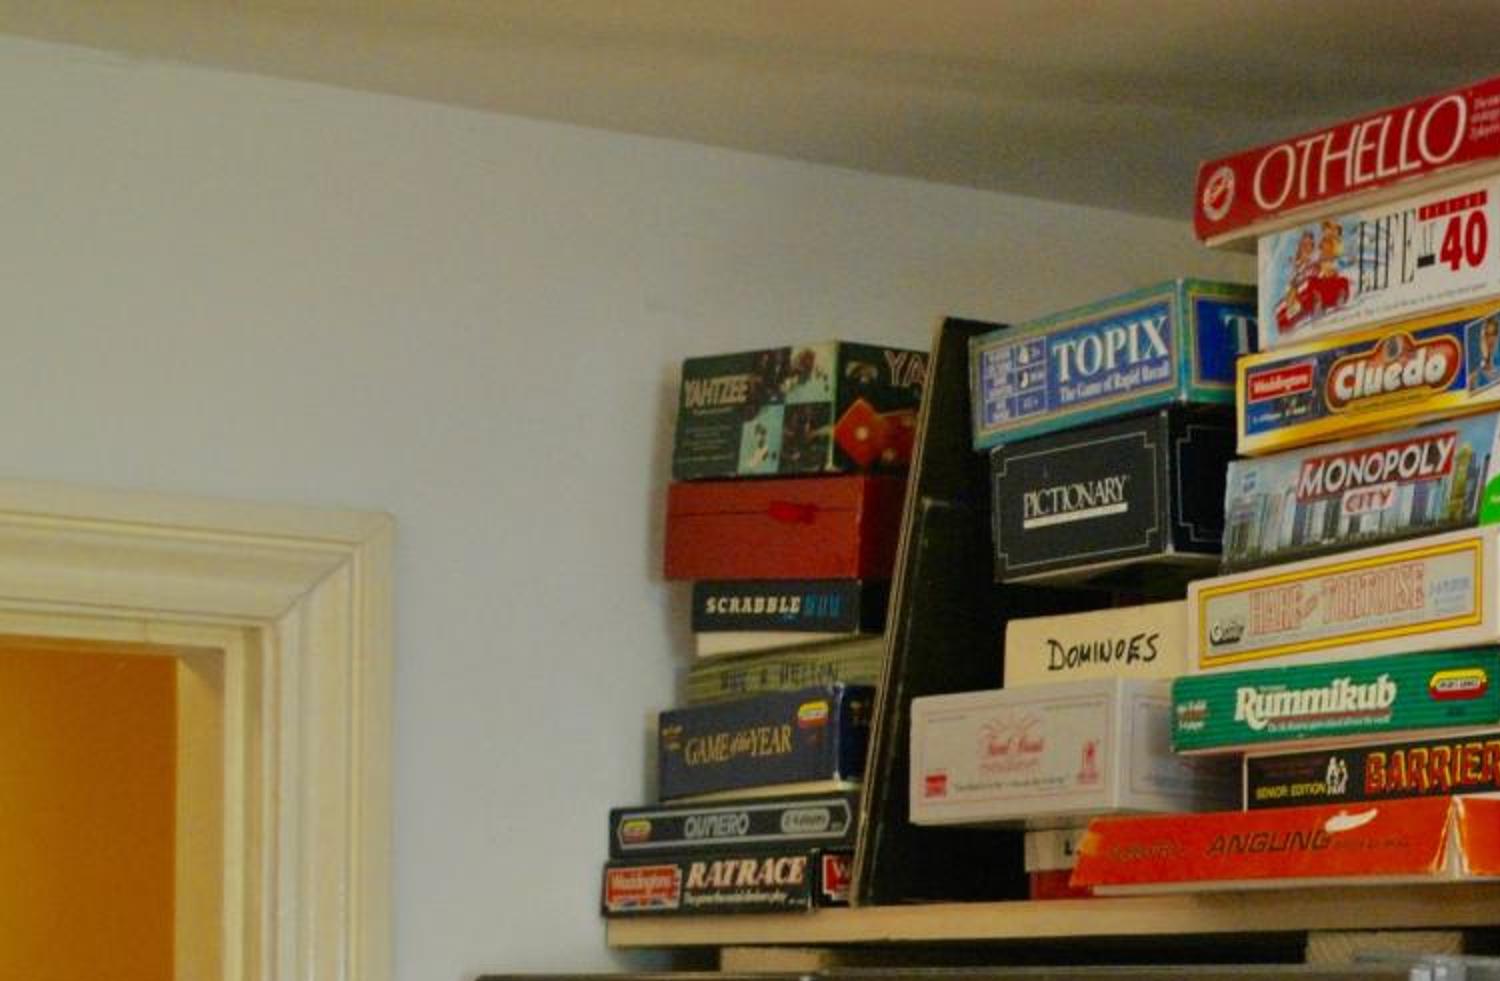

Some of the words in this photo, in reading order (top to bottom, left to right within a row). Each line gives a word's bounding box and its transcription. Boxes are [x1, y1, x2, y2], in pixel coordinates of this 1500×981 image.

[1253, 95, 1467, 209] OTHELLO
[1439, 210, 1488, 271] 40
[1053, 315, 1169, 383] TOPIX
[685, 374, 749, 407] YAHTZEE
[1334, 347, 1446, 401] Cluedo
[1299, 434, 1456, 499] MONOPOLY
[1024, 475, 1127, 519] PICTIONARY
[1344, 487, 1392, 513] CITY
[705, 596, 800, 614] SCRABBLE
[1047, 634, 1159, 671] DOMINOES
[1234, 673, 1397, 730] Rummikub
[686, 732, 731, 767] GAME
[750, 724, 793, 757] YEAR
[1209, 831, 1329, 856] ANGLING
[685, 857, 807, 888] RATRACE
